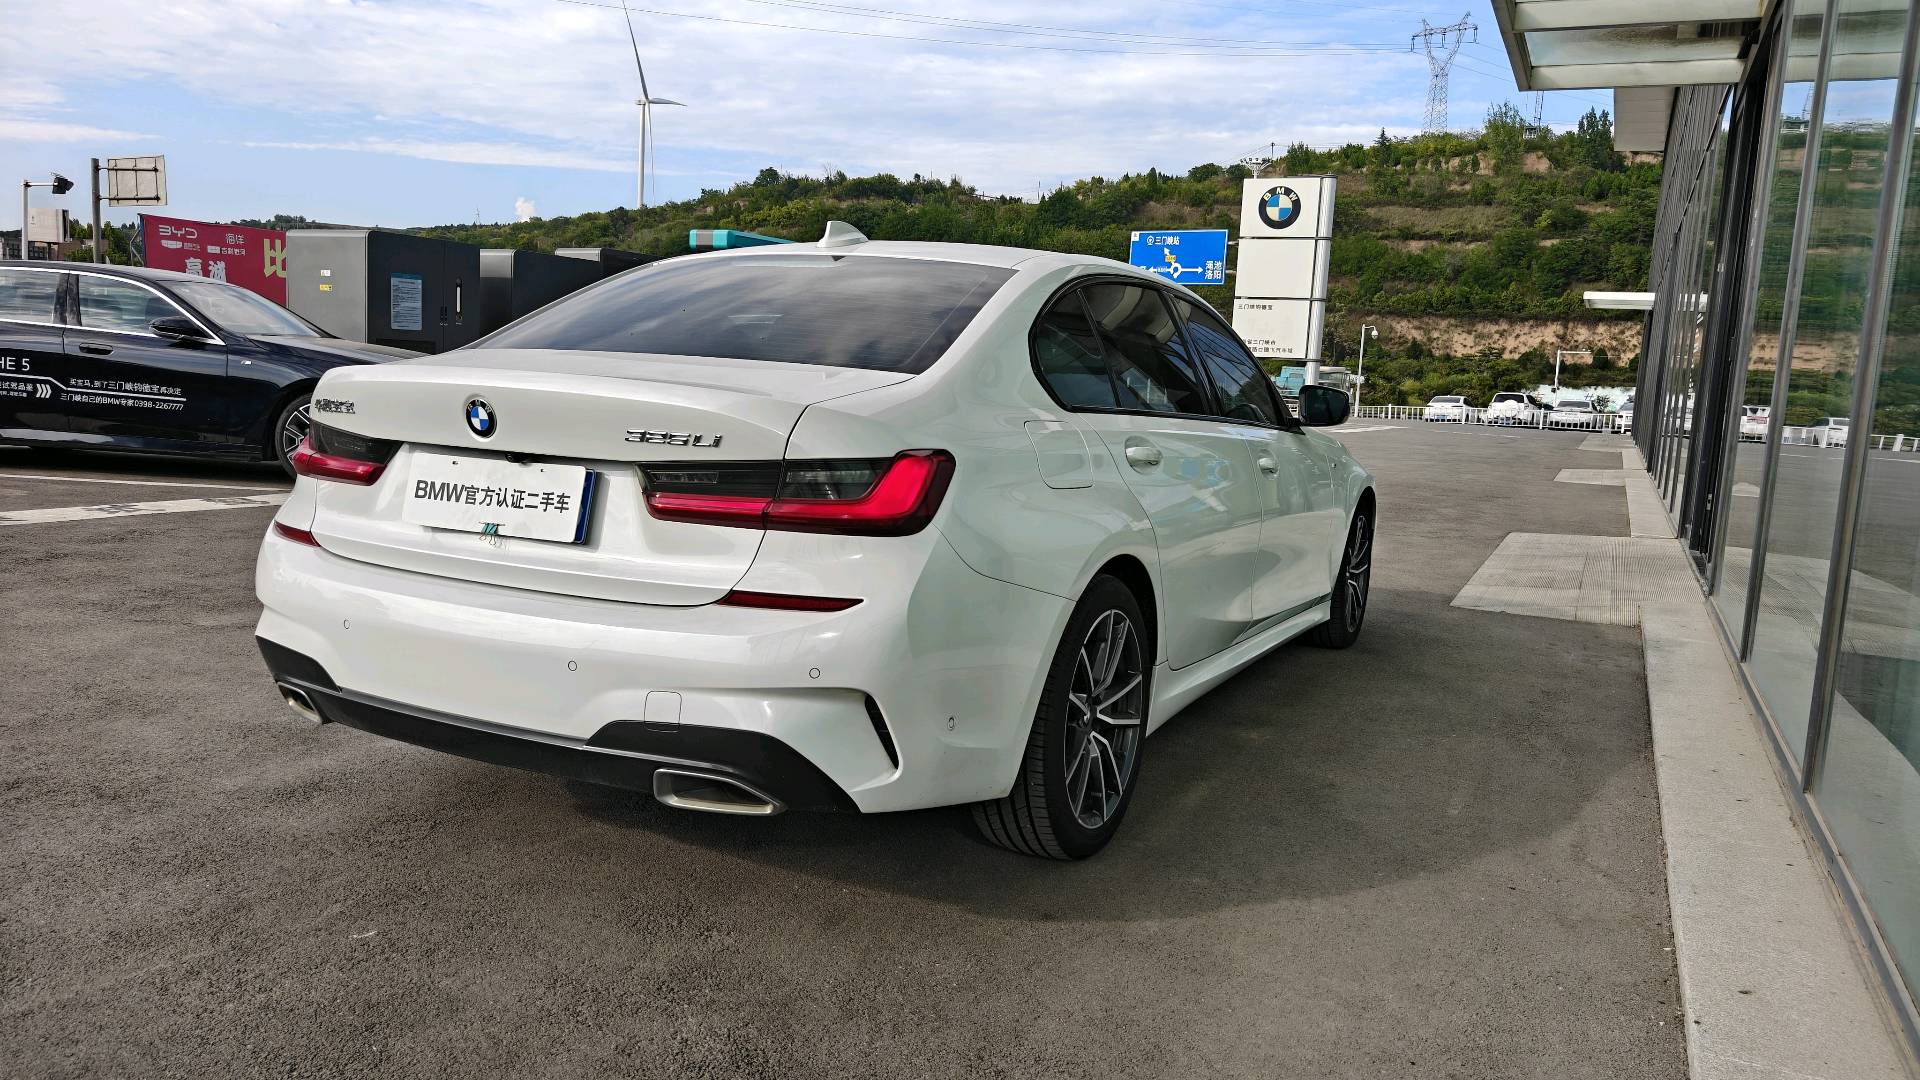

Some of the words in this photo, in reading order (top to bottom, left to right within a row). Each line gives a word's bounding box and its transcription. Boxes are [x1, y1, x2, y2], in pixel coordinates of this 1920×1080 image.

[158, 225, 198, 239] BYD
[1155, 236, 1180, 246] 三门峡站
[263, 238, 287, 278] 比
[1204, 270, 1221, 279] 洛阳
[21, 358, 30, 371] 5
[0, 381, 33, 392] 试驾品鉴
[625, 429, 722, 448] 325Li
[414, 480, 571, 514] BMW官方认证二手车
